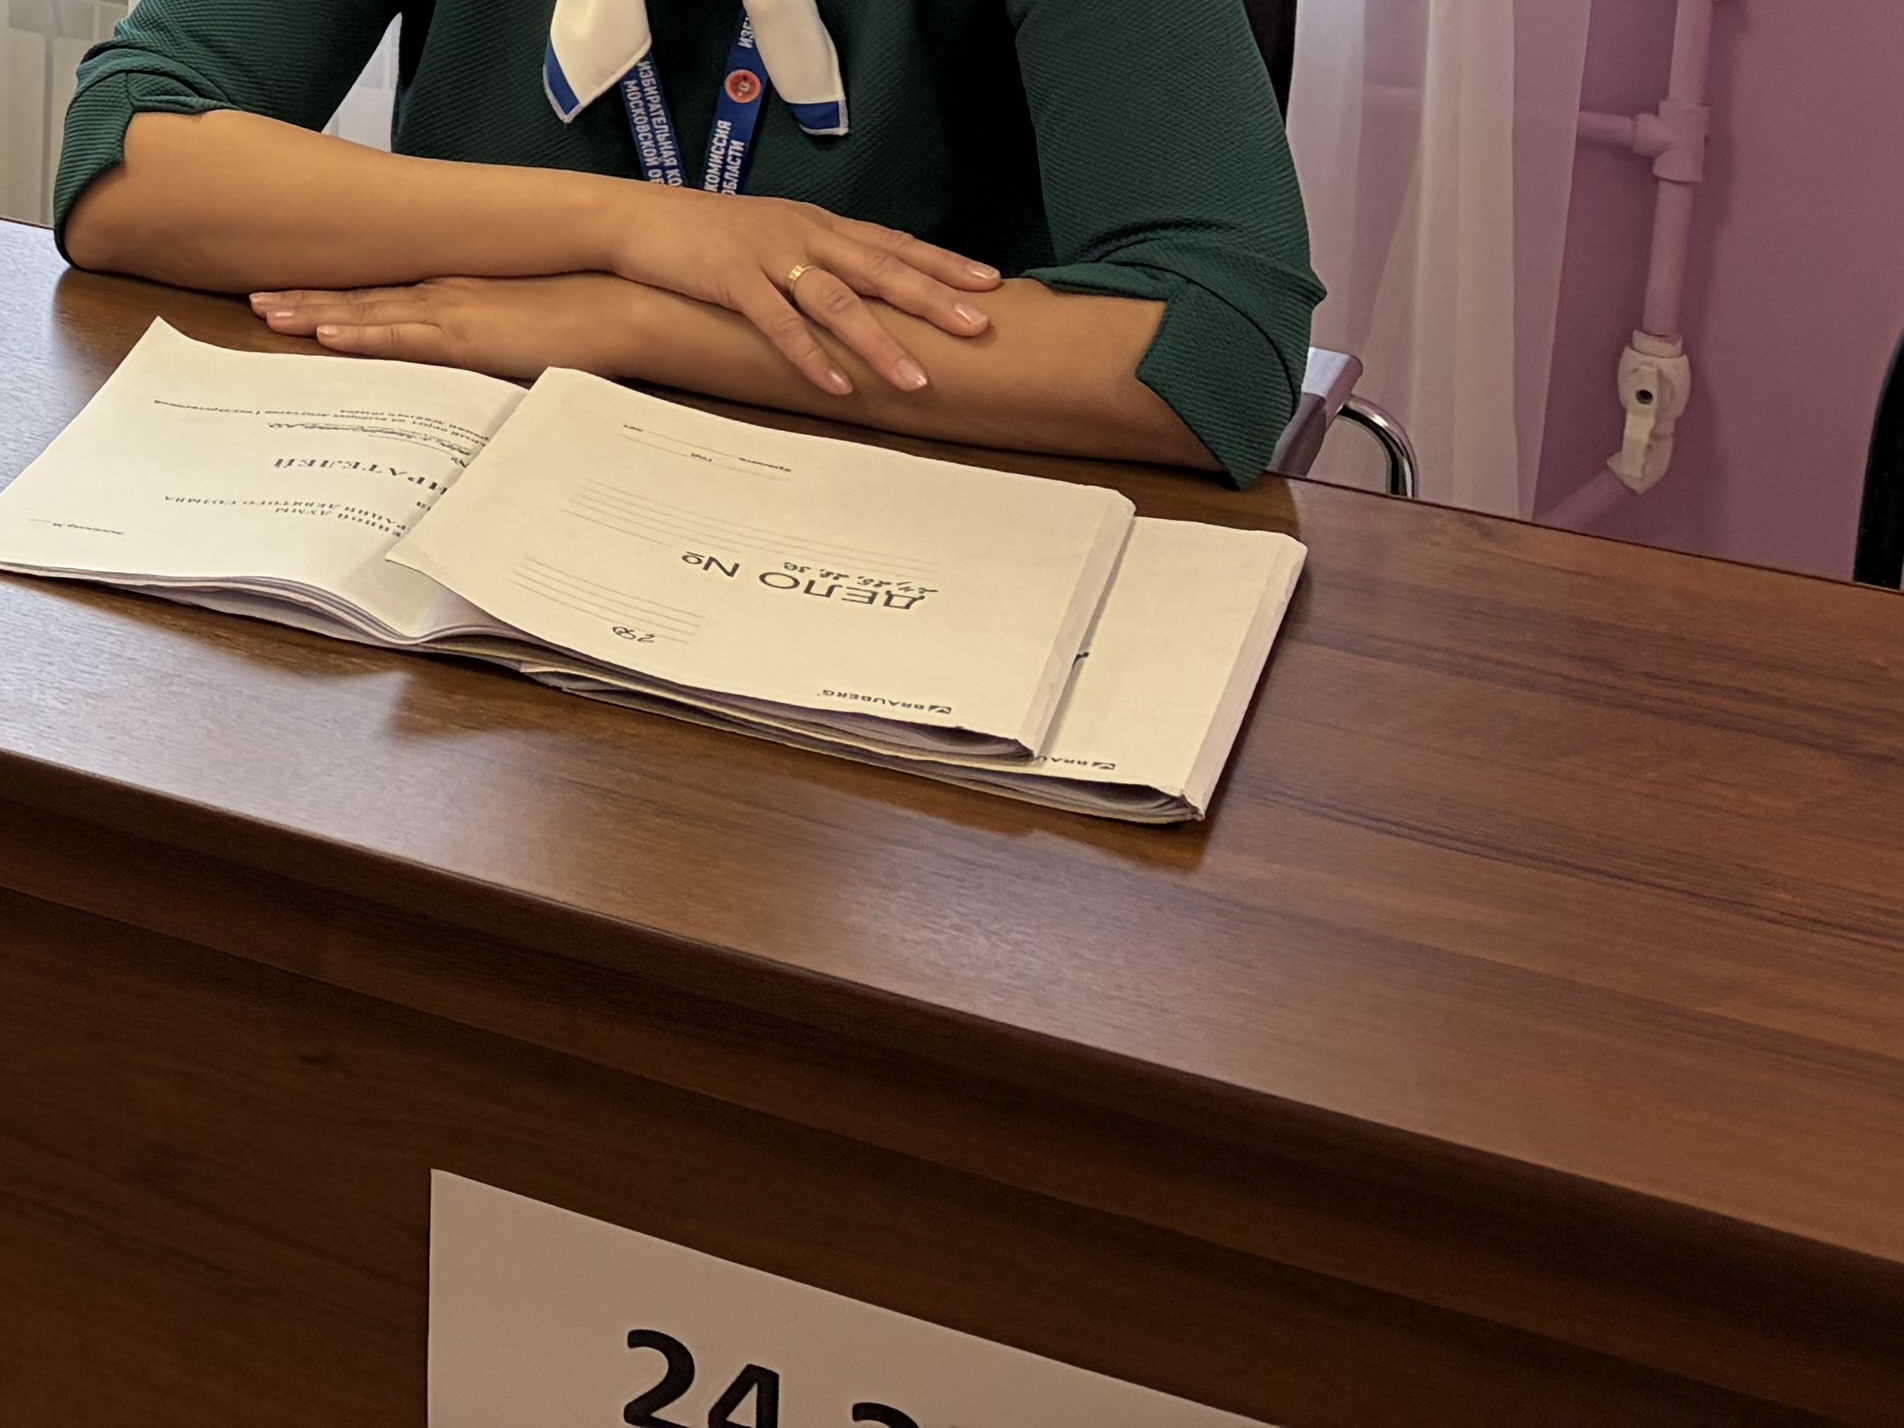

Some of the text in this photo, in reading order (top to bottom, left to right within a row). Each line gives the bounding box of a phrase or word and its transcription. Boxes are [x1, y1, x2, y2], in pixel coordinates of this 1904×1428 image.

[623, 79, 661, 166] МОСКОВСКОЙ
[636, 60, 676, 166] ИЗБИРАТЕЛЬНАЯ
[701, 118, 732, 192] КОМИССИЯ
[681, 551, 926, 610] ДЕЛО №
[821, 689, 926, 711] BRAUBERG
